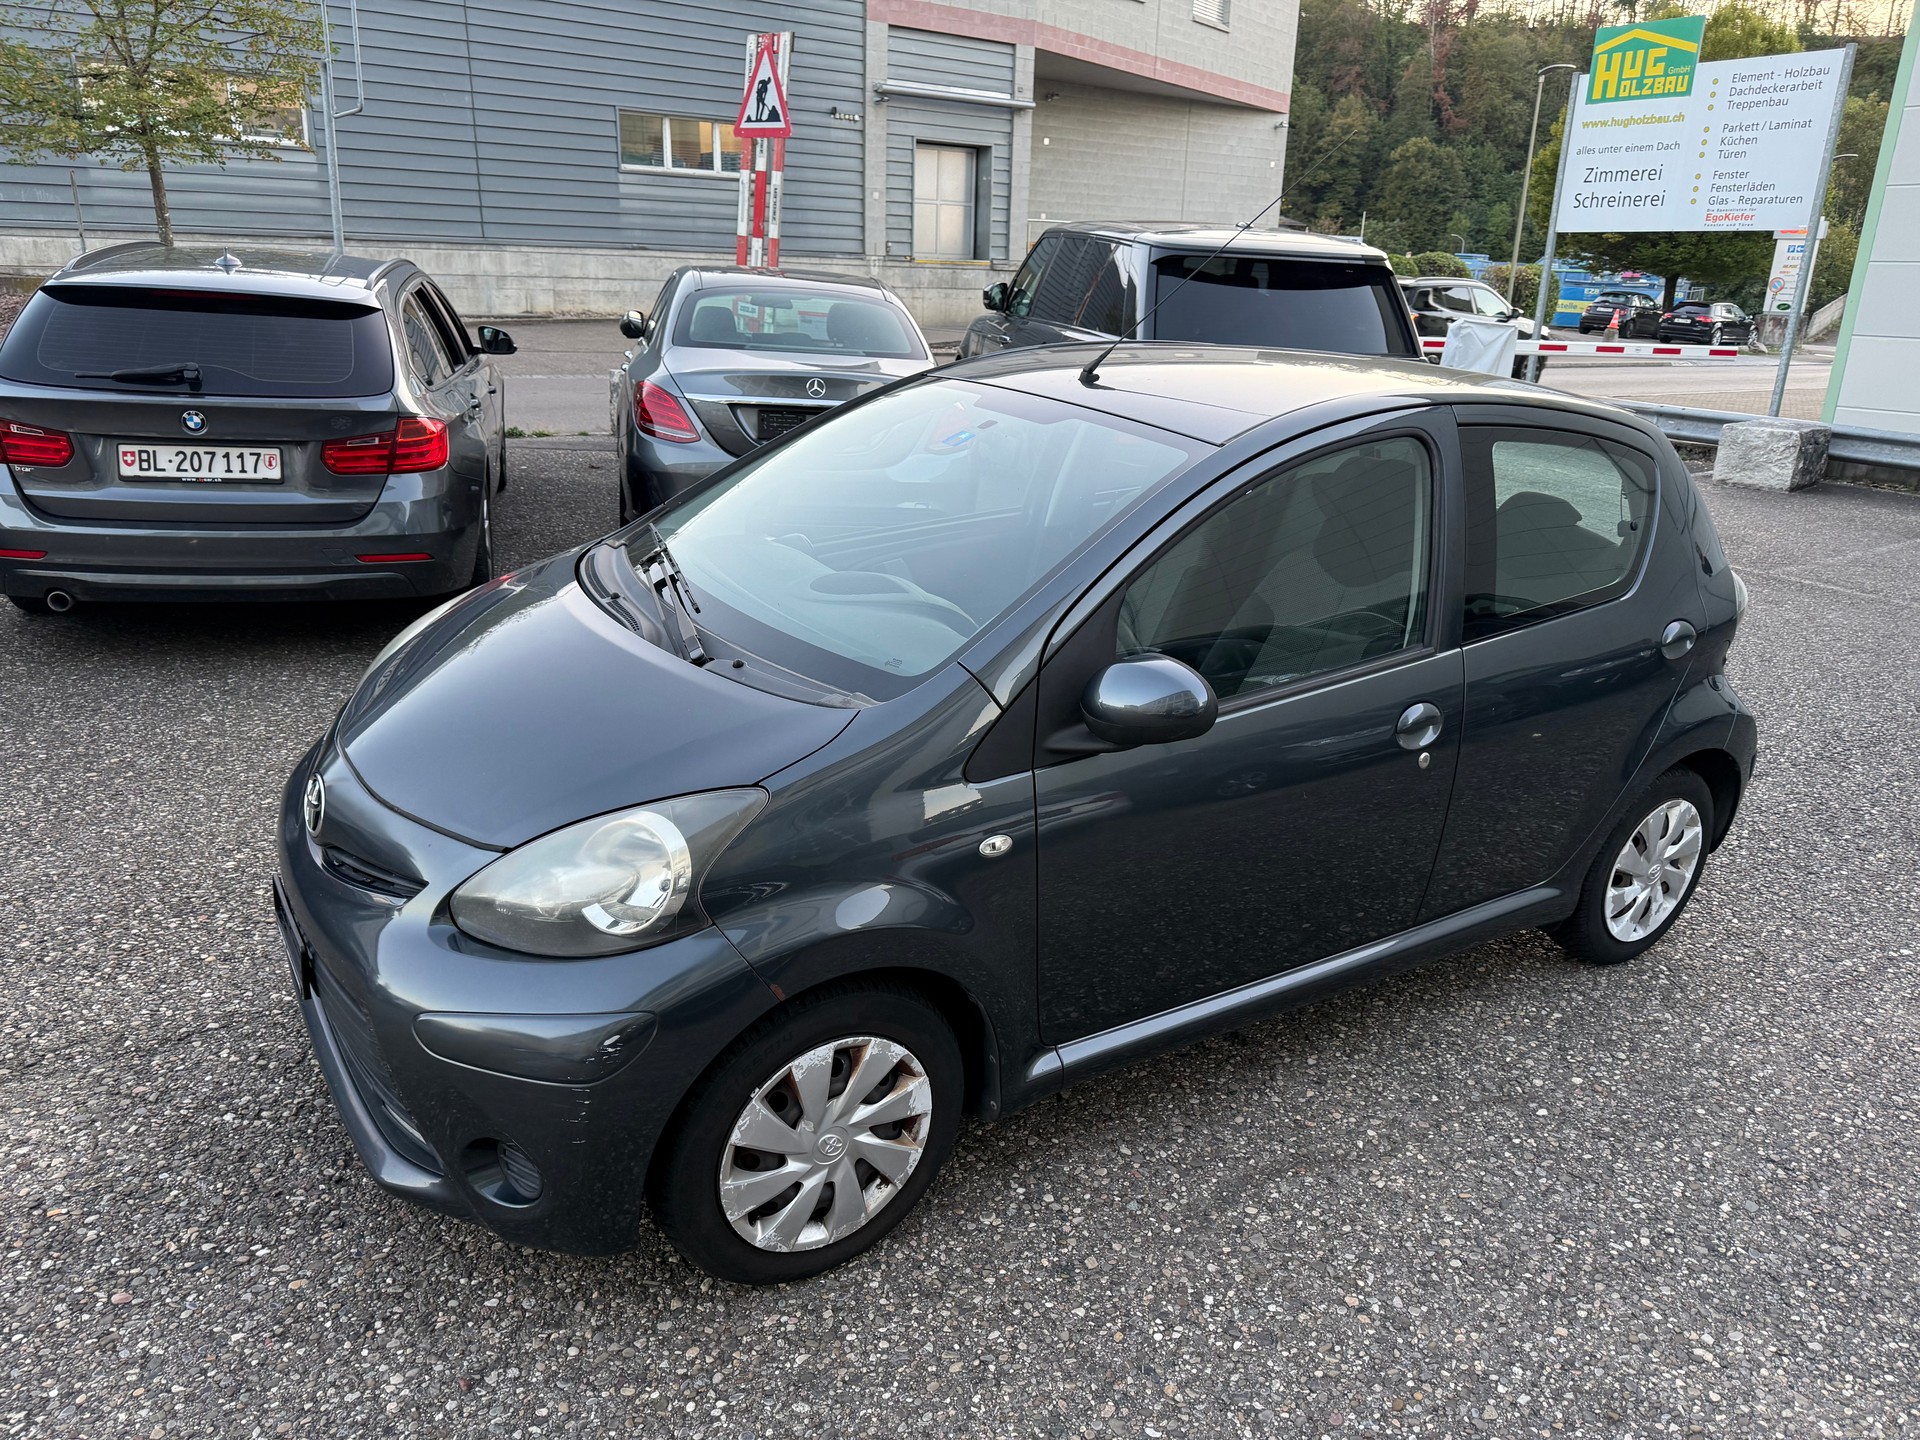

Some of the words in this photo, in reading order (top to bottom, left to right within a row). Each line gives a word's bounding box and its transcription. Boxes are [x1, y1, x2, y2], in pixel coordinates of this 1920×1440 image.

[1592, 47, 1668, 99] HUG
[1668, 65, 1691, 75] GmbH
[1731, 70, 1775, 83] Element
[1784, 66, 1830, 79] Holzbau
[1729, 79, 1823, 97] Dachdeckerarbeit
[1727, 97, 1789, 111] Treppenbau
[1582, 112, 1685, 128] www.hugholzbau.ch
[1722, 122, 1760, 133] Parkett
[1768, 119, 1812, 131] Laminat
[1720, 135, 1758, 146] Küchen
[1576, 146, 1596, 156] alles
[1598, 145, 1622, 154] unter
[1625, 143, 1654, 153] einem
[1656, 141, 1680, 151] Dach
[1718, 149, 1747, 159] Türen
[1583, 164, 1664, 183] Zimmerei
[1712, 170, 1750, 180] Fenster
[1710, 181, 1775, 193] Fensterläden
[1573, 190, 1666, 209] Schreinerei
[1708, 195, 1729, 206] Glas
[1738, 194, 1803, 207] Reparaturen
[1705, 212, 1755, 223] EgoKiefer
